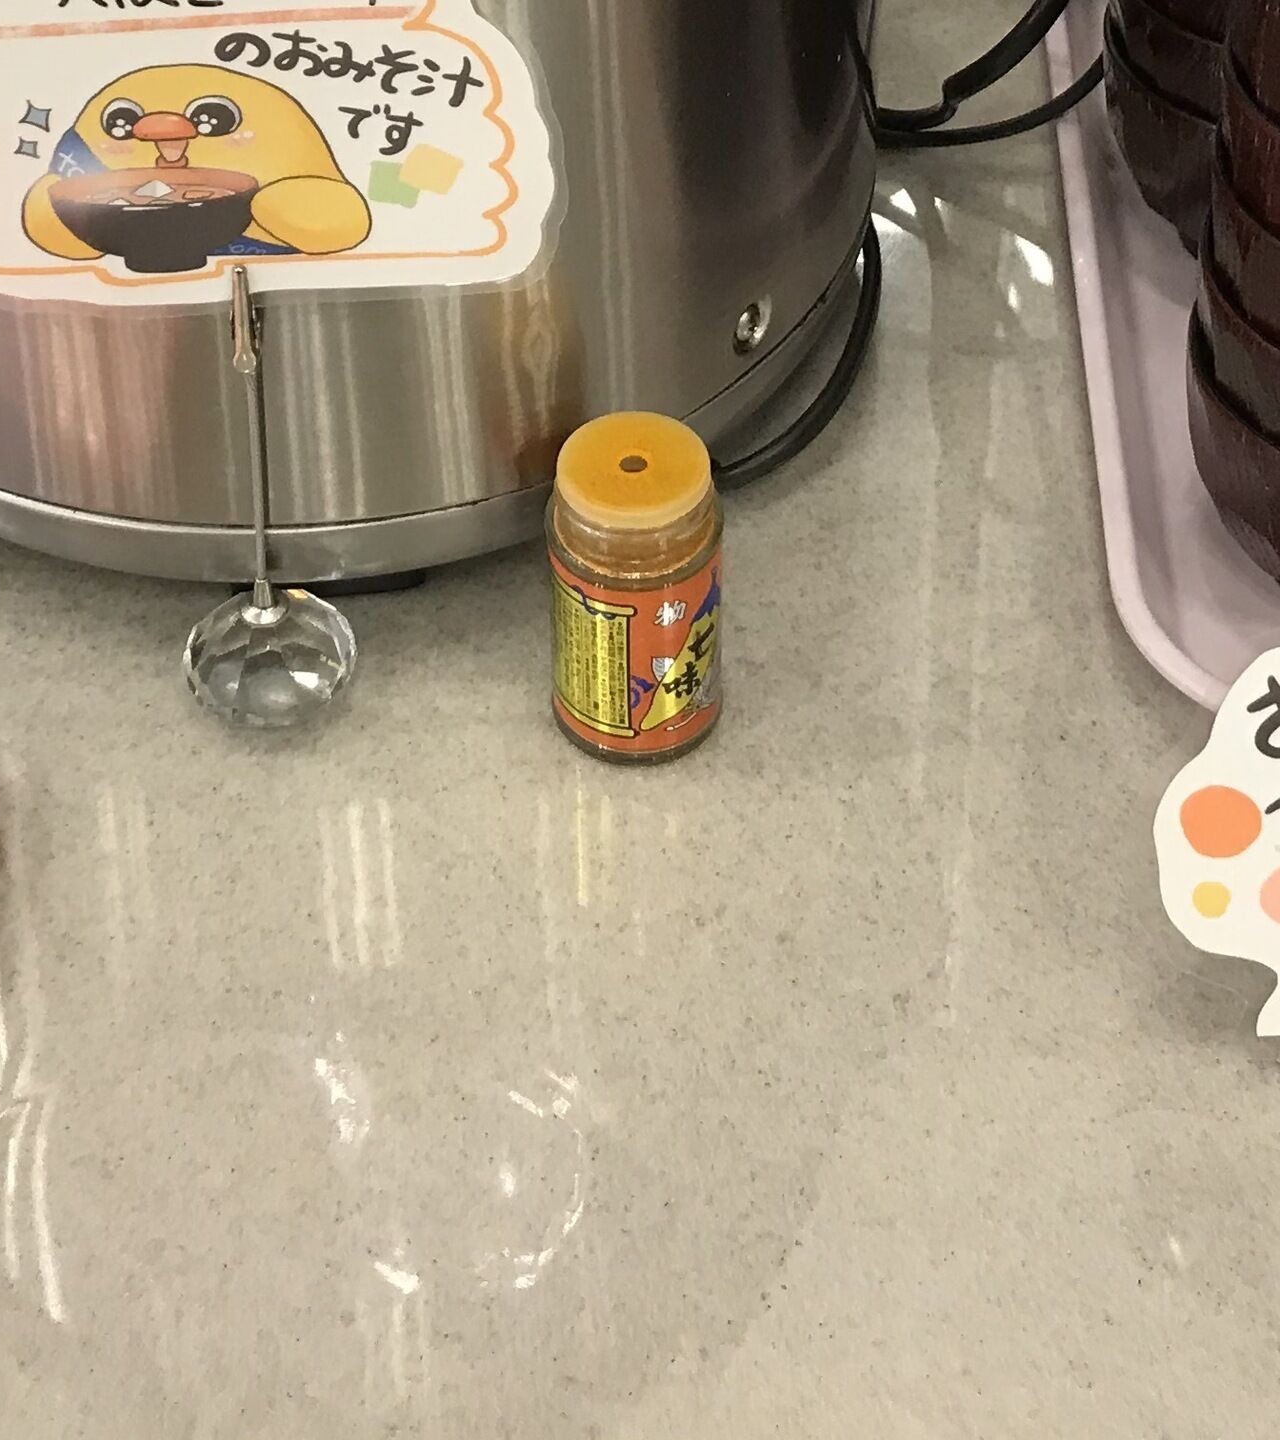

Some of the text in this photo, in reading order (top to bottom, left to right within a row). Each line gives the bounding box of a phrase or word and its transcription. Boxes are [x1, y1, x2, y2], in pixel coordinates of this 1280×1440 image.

[214, 30, 485, 108] のおみそ汁
[338, 104, 424, 157] です
